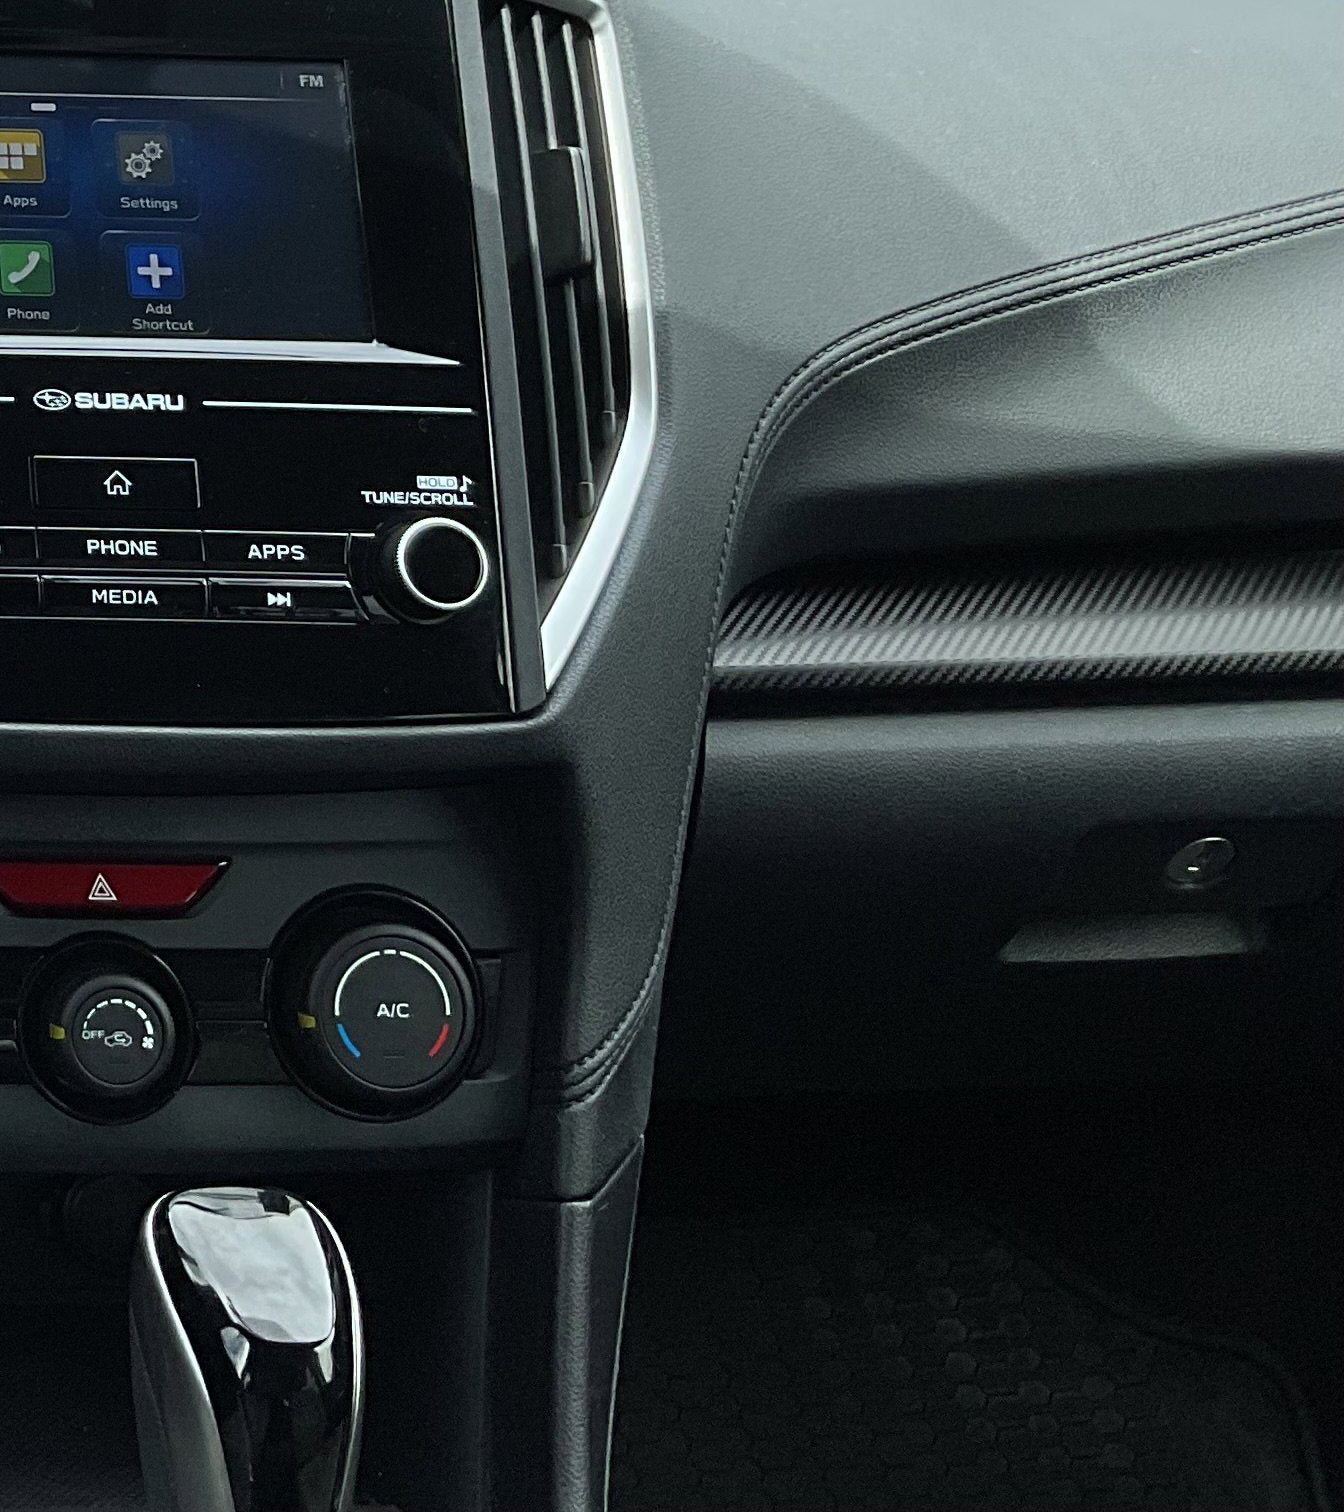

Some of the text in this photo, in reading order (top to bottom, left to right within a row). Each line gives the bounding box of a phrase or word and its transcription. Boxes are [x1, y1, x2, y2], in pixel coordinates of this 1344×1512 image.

[299, 74, 324, 87] FM
[3, 194, 38, 209] Apps
[120, 197, 179, 211] Settings
[7, 308, 51, 321] Phone
[145, 303, 172, 315] Add
[132, 318, 194, 332] Shortcut
[74, 392, 184, 411] SUBARU
[418, 477, 457, 488] HOLD
[361, 490, 474, 506] TUNE/SCROLL
[87, 539, 158, 556] PHONE
[247, 544, 306, 561] APPS
[92, 589, 159, 605] MEDIA
[376, 1002, 410, 1018] A/C
[82, 1029, 105, 1040] OFF
